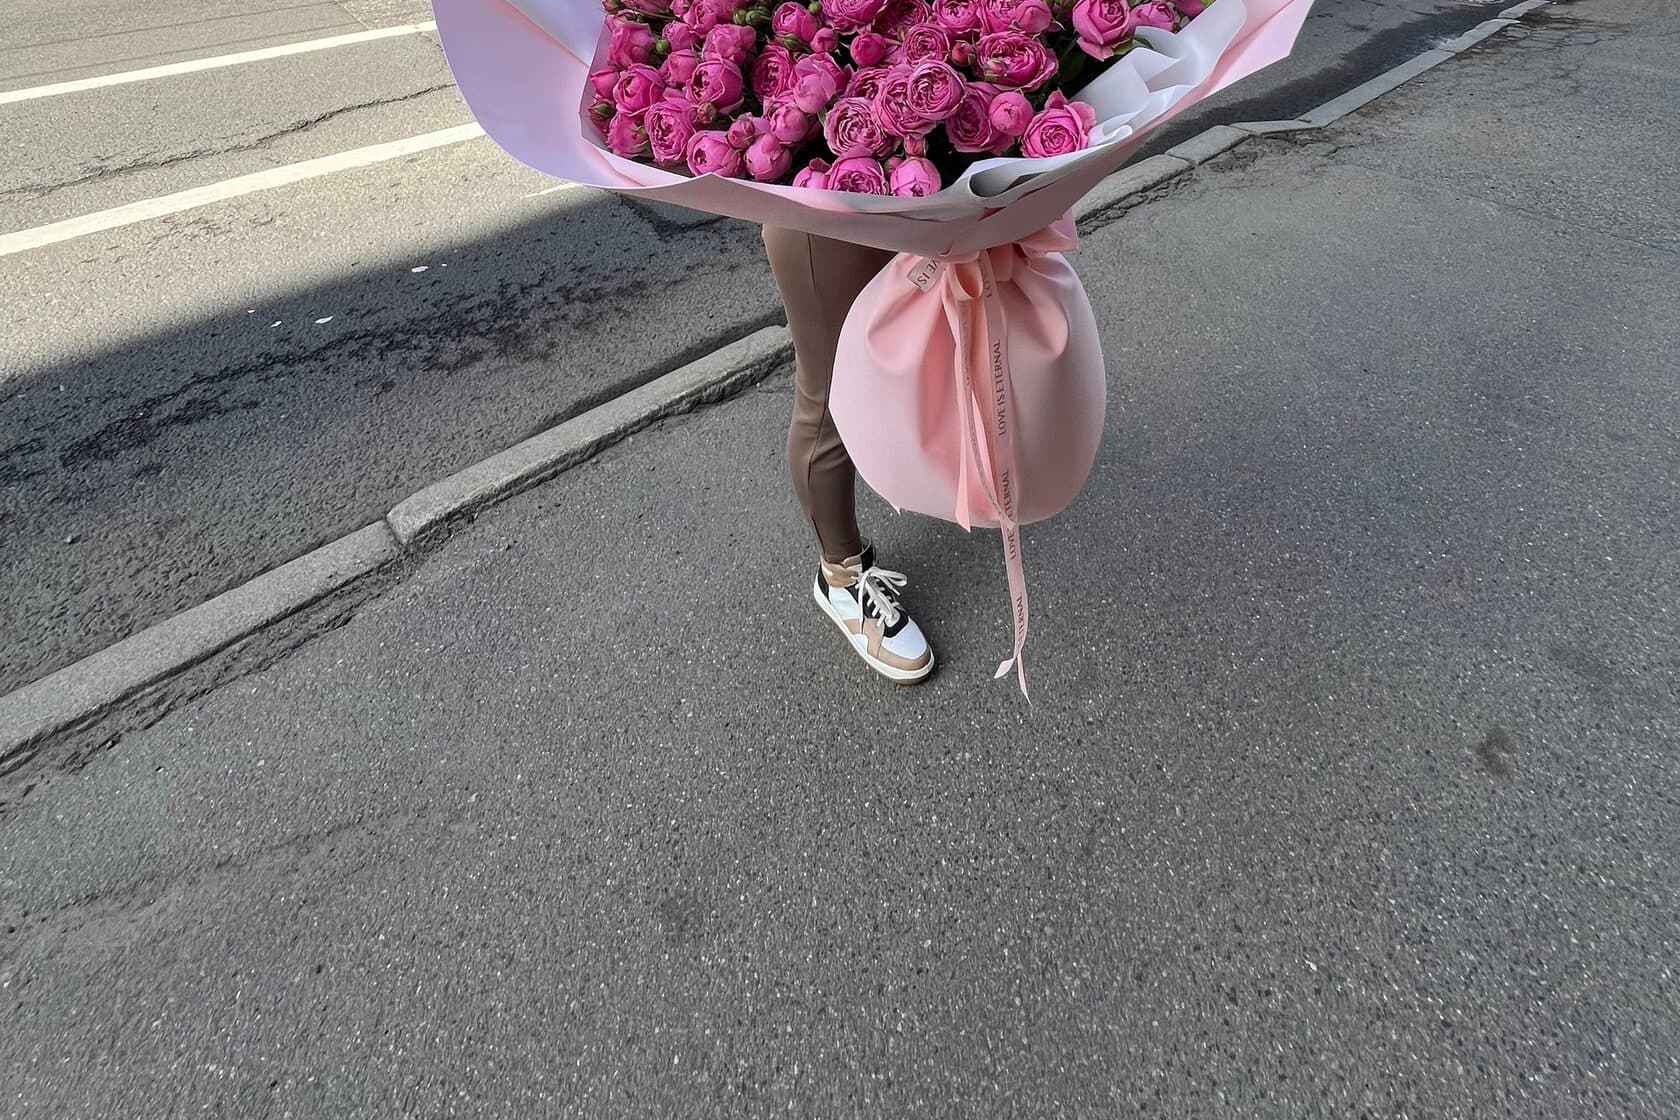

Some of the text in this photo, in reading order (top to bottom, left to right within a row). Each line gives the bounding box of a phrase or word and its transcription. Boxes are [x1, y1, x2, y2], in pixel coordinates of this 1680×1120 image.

[993, 340, 1007, 436] LOVE IS ETERNAL
